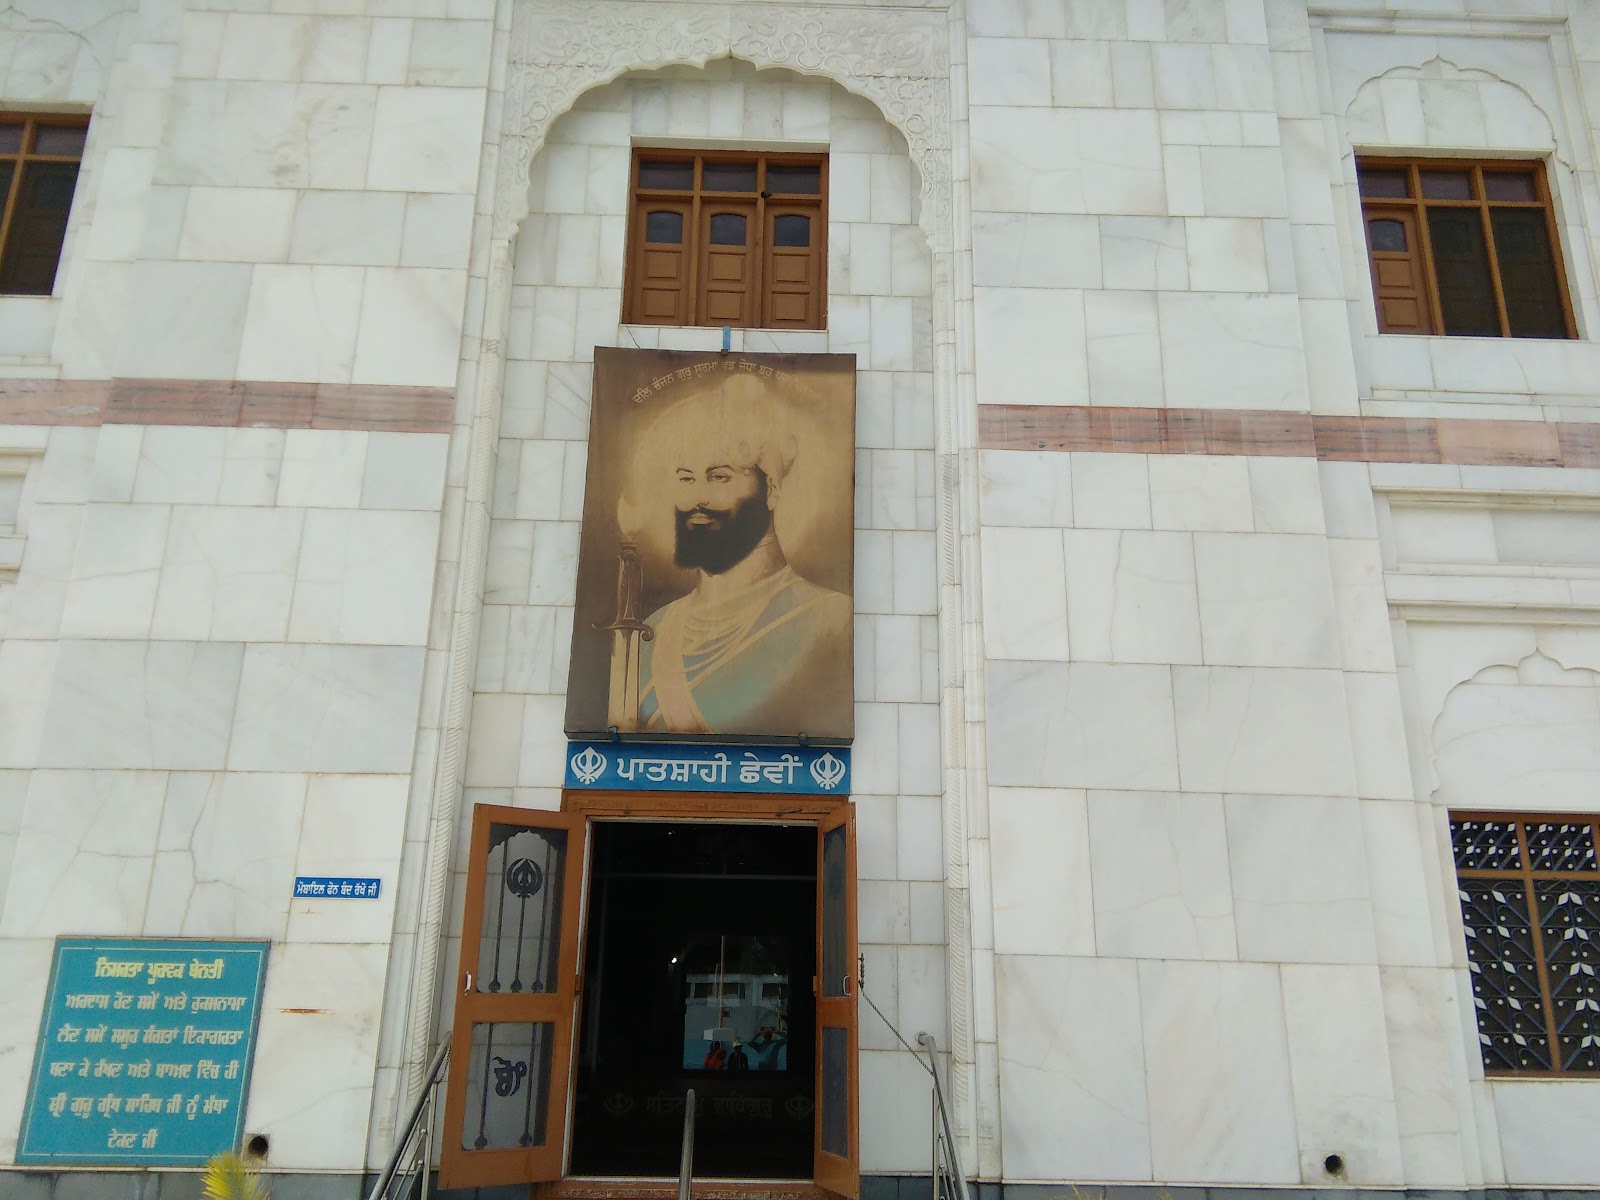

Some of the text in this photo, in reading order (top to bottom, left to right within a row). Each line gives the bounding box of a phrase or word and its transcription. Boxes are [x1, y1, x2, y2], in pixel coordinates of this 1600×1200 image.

[616, 752, 804, 785] ਪਾਤਸ਼ਾਹੀ ਛੇਵੀਂ
[341, 881, 353, 896] ਬੰਦ
[368, 882, 377, 896] ਜੀ
[189, 958, 225, 979] ਬੇਨਤੀ
[65, 994, 110, 1010] ਅਰਦਾਸ
[163, 991, 188, 1011] ਅਤੇ
[78, 1057, 91, 1077] ਕੇ
[128, 1058, 151, 1078] ਅਤੇ
[224, 1060, 240, 1080] ਹੀ
[70, 1097, 94, 1118] ਗੁਰੂ
[125, 1093, 163, 1113] ਸਾਹਿਬ
[166, 1093, 183, 1114] ਜੀ
[141, 1128, 159, 1149] ਜੀ
